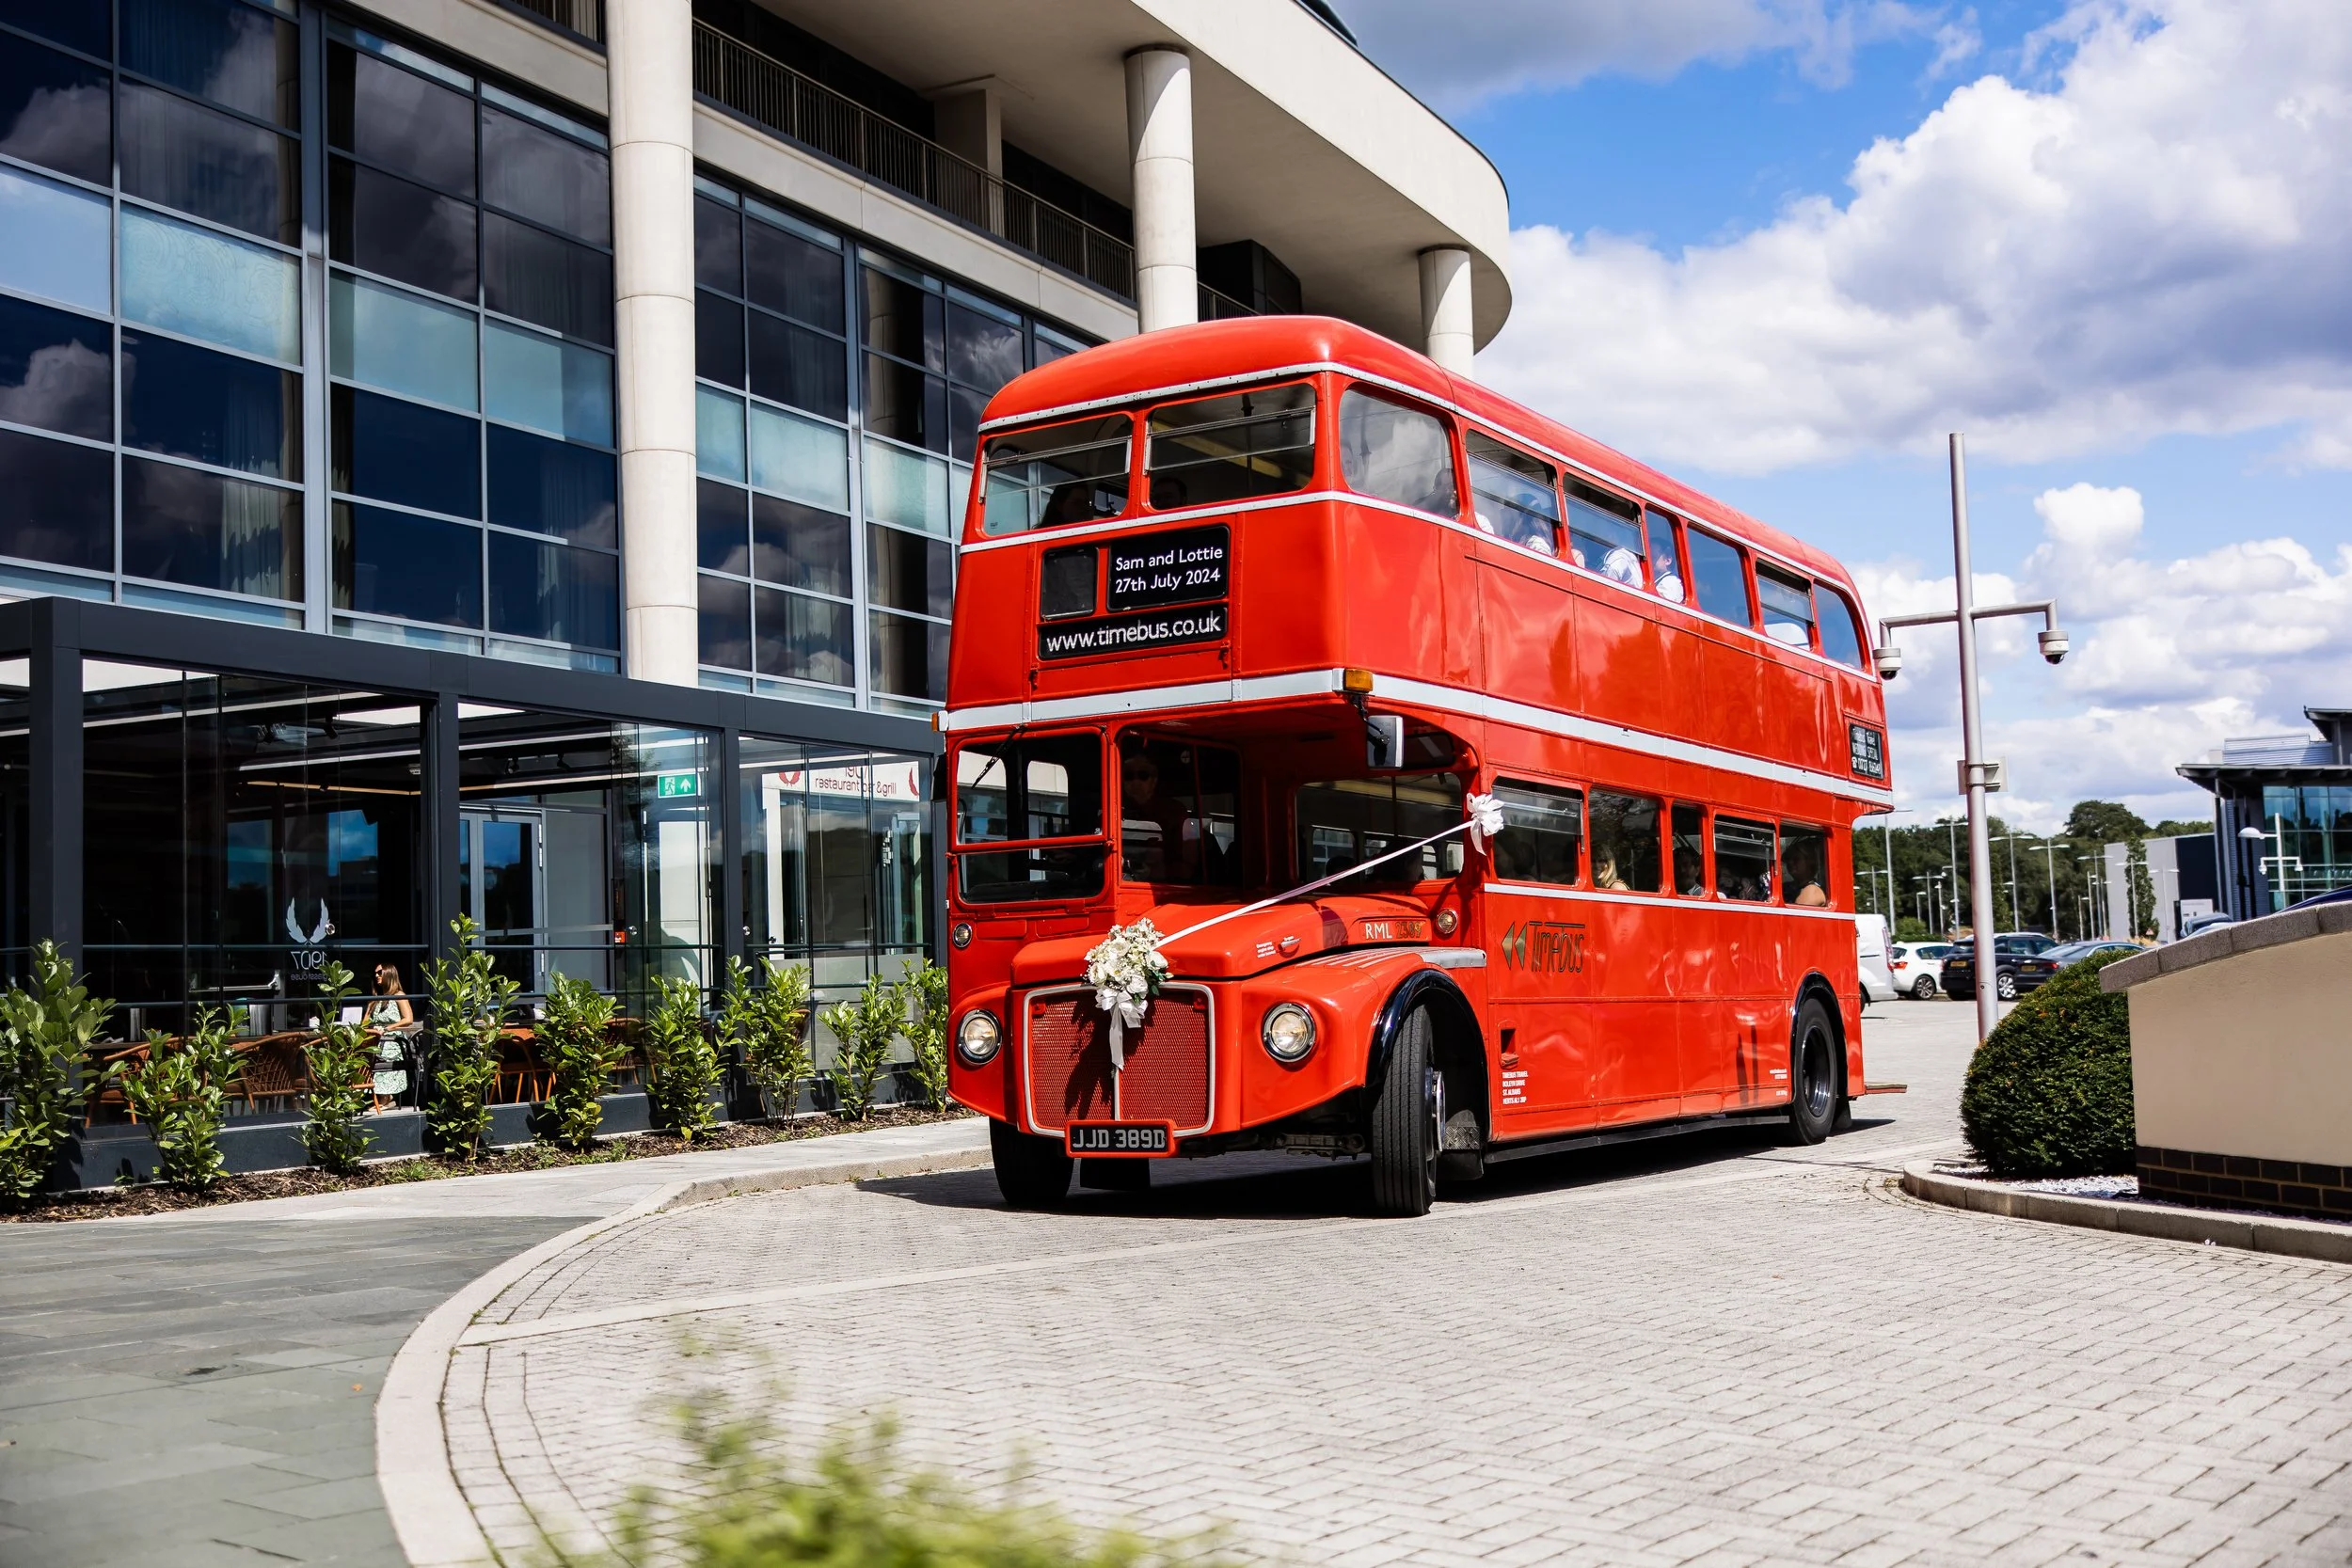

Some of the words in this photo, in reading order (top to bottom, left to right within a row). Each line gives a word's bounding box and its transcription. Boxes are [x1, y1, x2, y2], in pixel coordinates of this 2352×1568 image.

[1116, 557, 1144, 571] Sam
[1148, 550, 1174, 567] and
[1179, 546, 1223, 563] Lottie
[1115, 577, 1146, 594] 27th
[1151, 573, 1182, 591] July
[1186, 567, 1220, 585] 2024
[1046, 610, 1221, 652] www.timebus.co.uk
[815, 777, 860, 792] restaurant
[1365, 922, 1392, 940] RML
[1073, 1129, 1109, 1148] JJD
[1115, 1129, 1166, 1148] 389D
